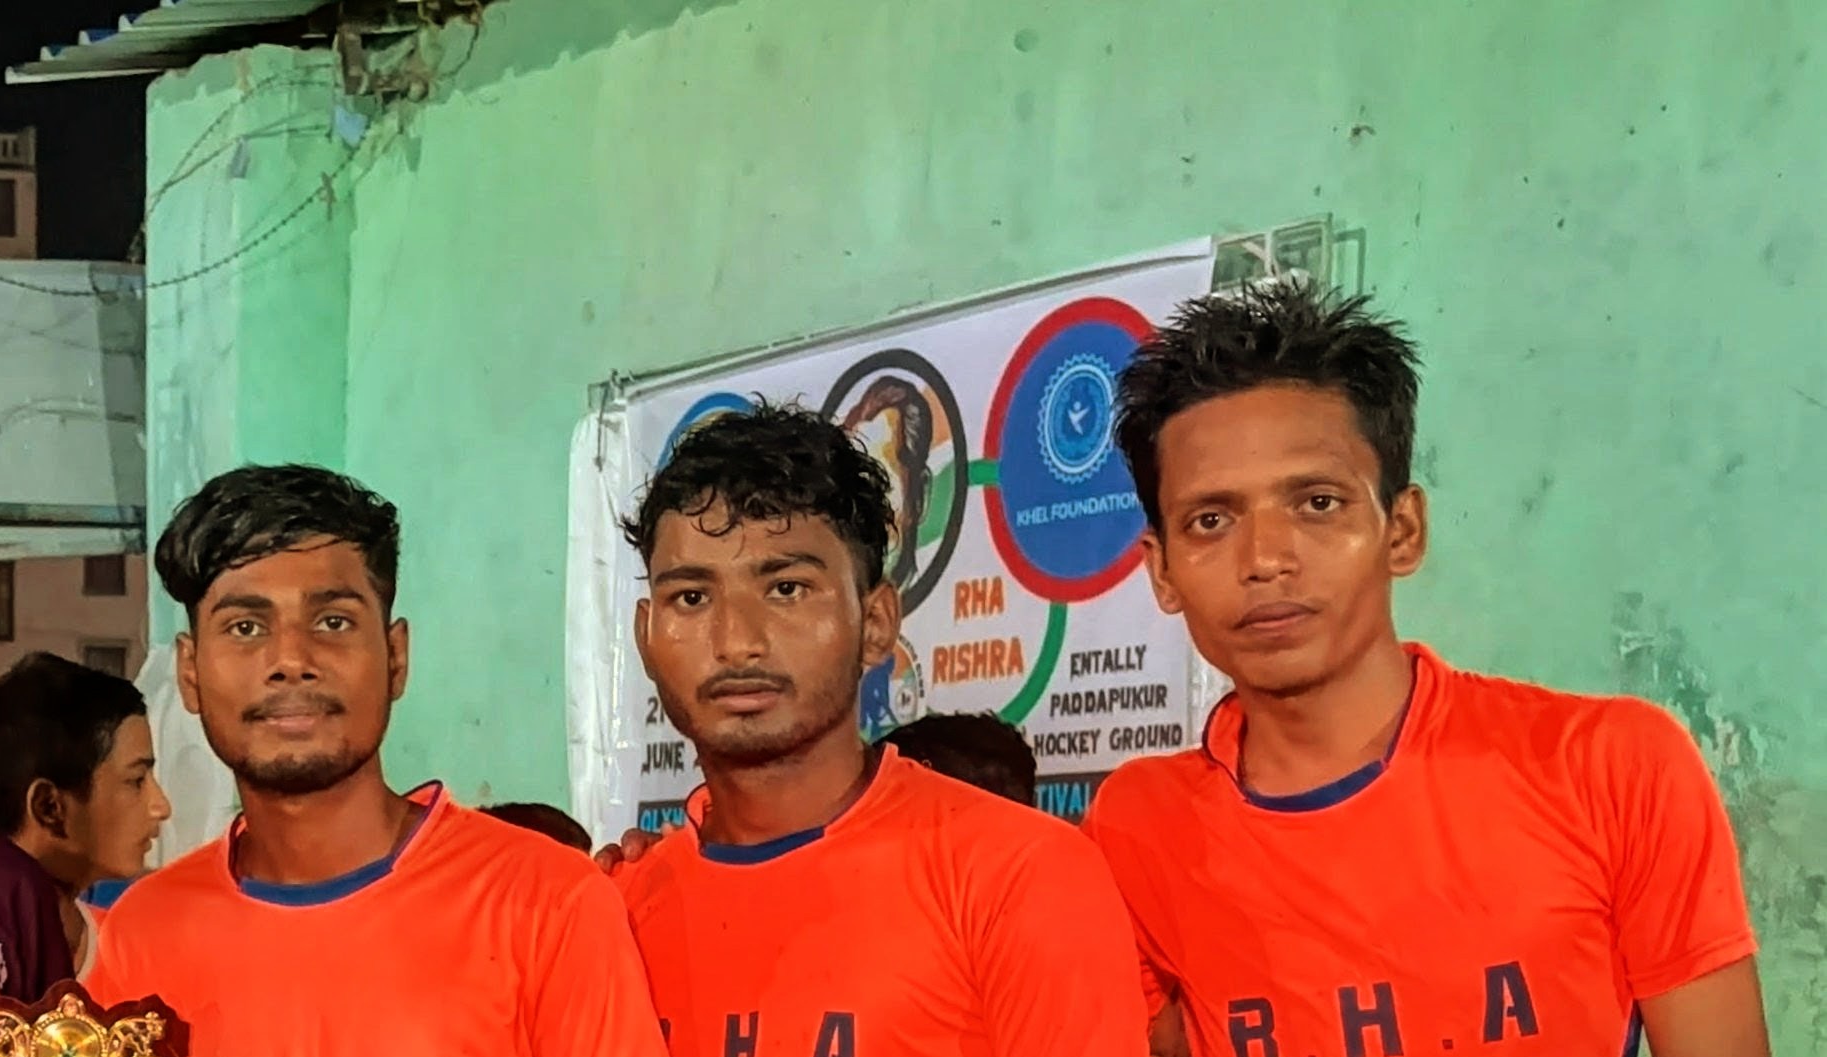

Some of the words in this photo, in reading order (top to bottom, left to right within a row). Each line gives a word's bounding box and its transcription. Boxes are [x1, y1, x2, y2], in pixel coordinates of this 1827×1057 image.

[1016, 506, 1049, 526] KHEL
[954, 576, 1006, 621] RHA
[932, 637, 1026, 686] RISHRA
[1070, 644, 1148, 678] ENTALLY
[1049, 684, 1169, 718] PADDAPUKUR
[1033, 728, 1102, 758] HOCKEY
[1109, 723, 1183, 752] GROUND
[641, 741, 686, 775] JUNE
[1034, 781, 1090, 815] TIVAL
